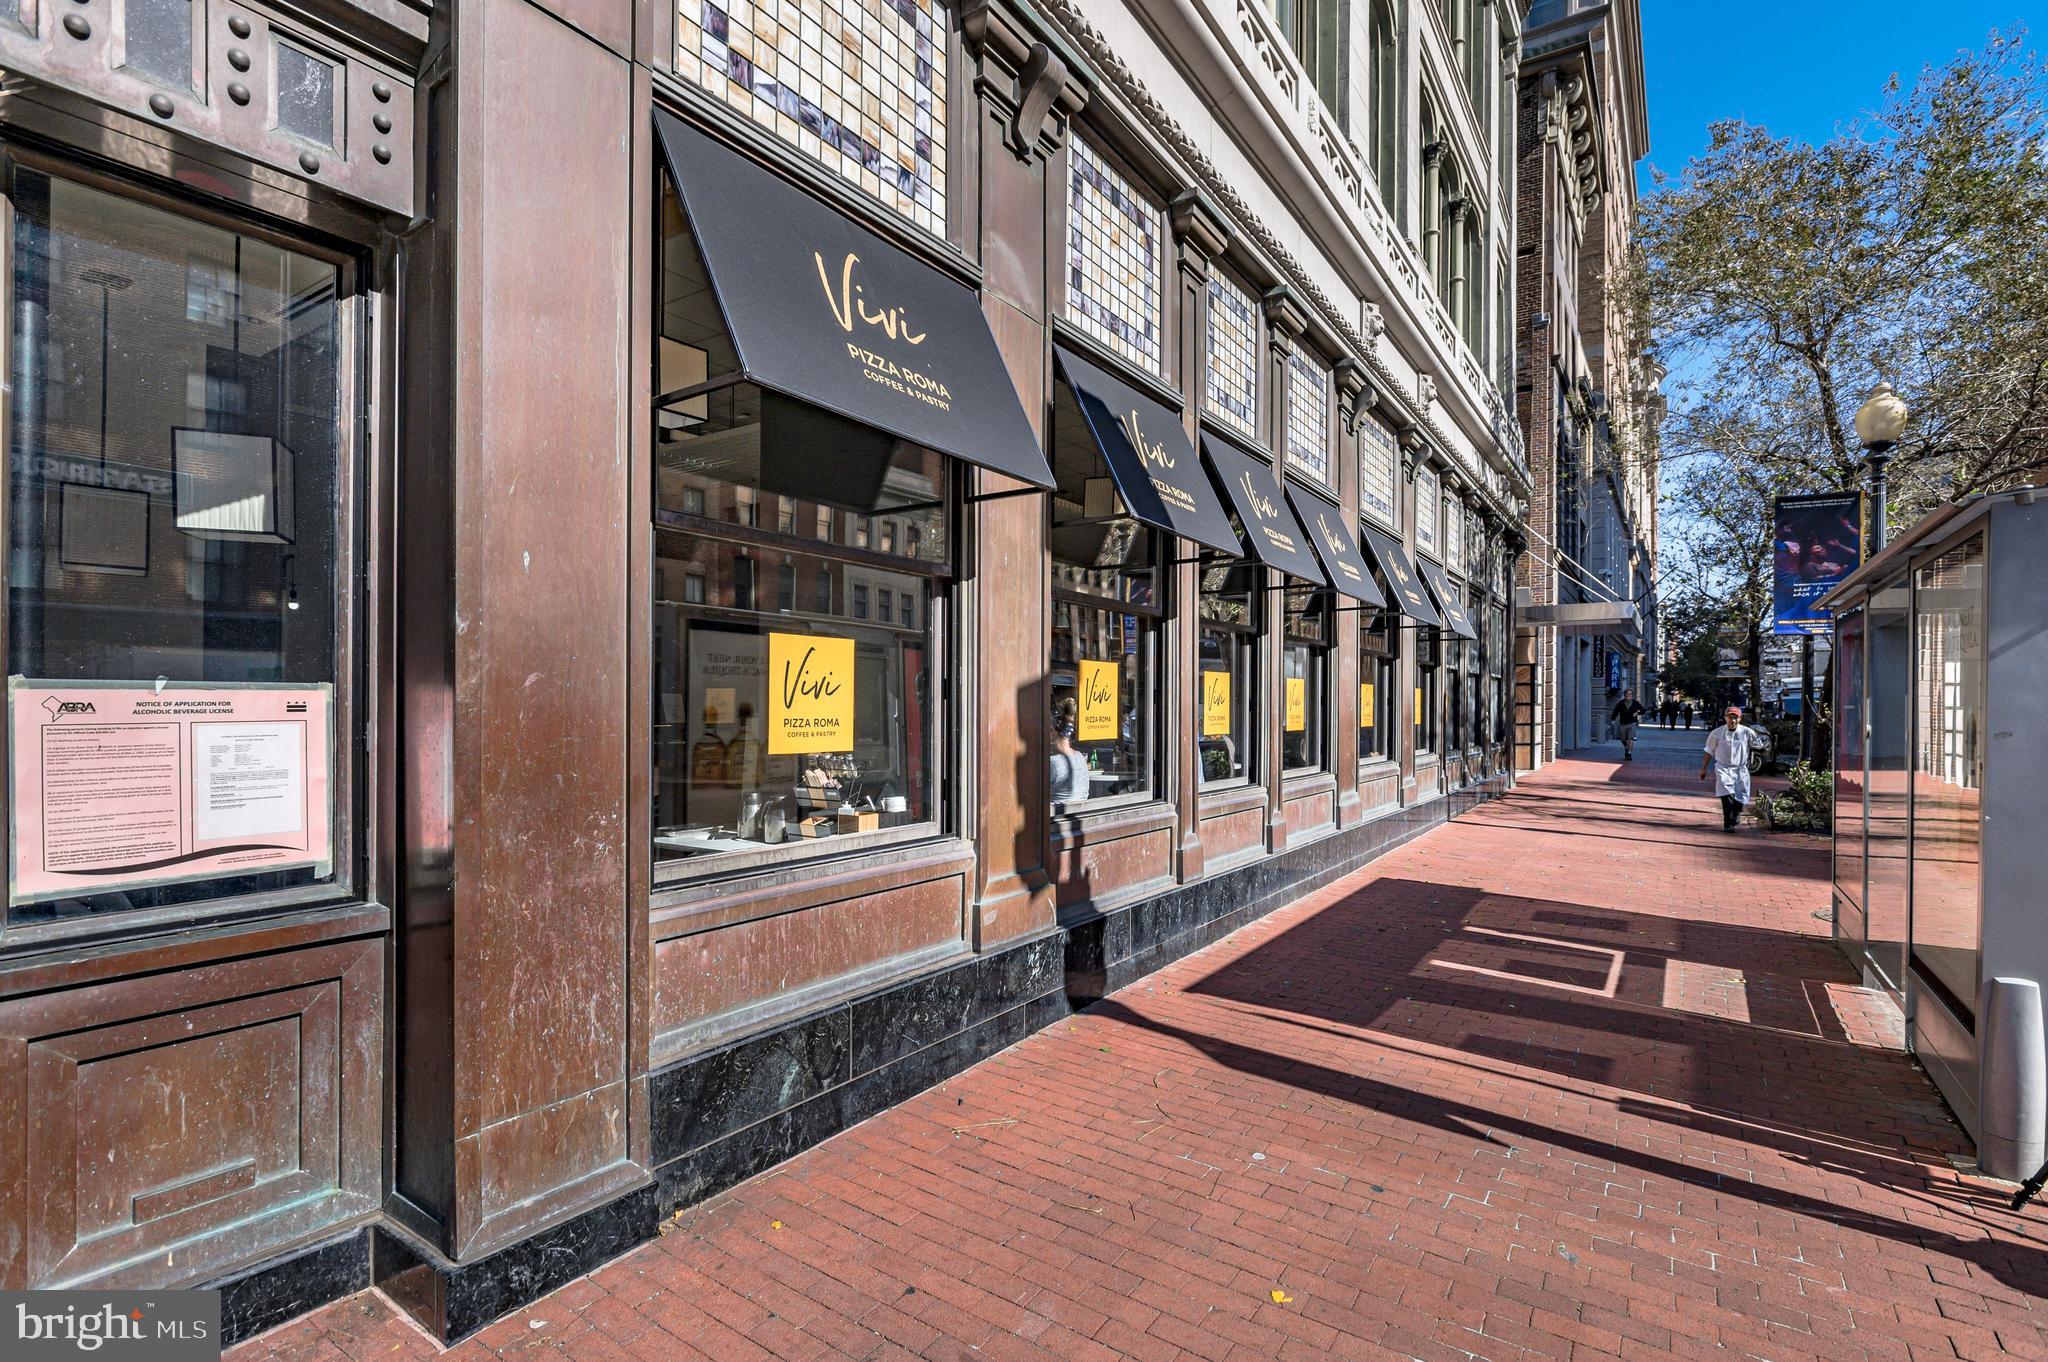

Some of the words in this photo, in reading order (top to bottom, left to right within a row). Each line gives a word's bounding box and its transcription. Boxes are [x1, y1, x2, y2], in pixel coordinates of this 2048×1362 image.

[815, 252, 927, 345] Vivi
[847, 343, 901, 378] PIZZA
[902, 367, 951, 399] ROMA
[863, 369, 905, 393] COFFEE
[906, 387, 915, 397] &
[915, 390, 950, 411] PASTRY
[1121, 409, 1175, 468] Vivi
[1240, 471, 1278, 520] Vivi
[784, 647, 841, 709] Vivi
[1085, 668, 1112, 711] Vivi
[1208, 678, 1226, 711] Vivi
[1611, 659, 1619, 689] PARK
[783, 719, 811, 728] PIZZA
[813, 718, 840, 727] ROMA
